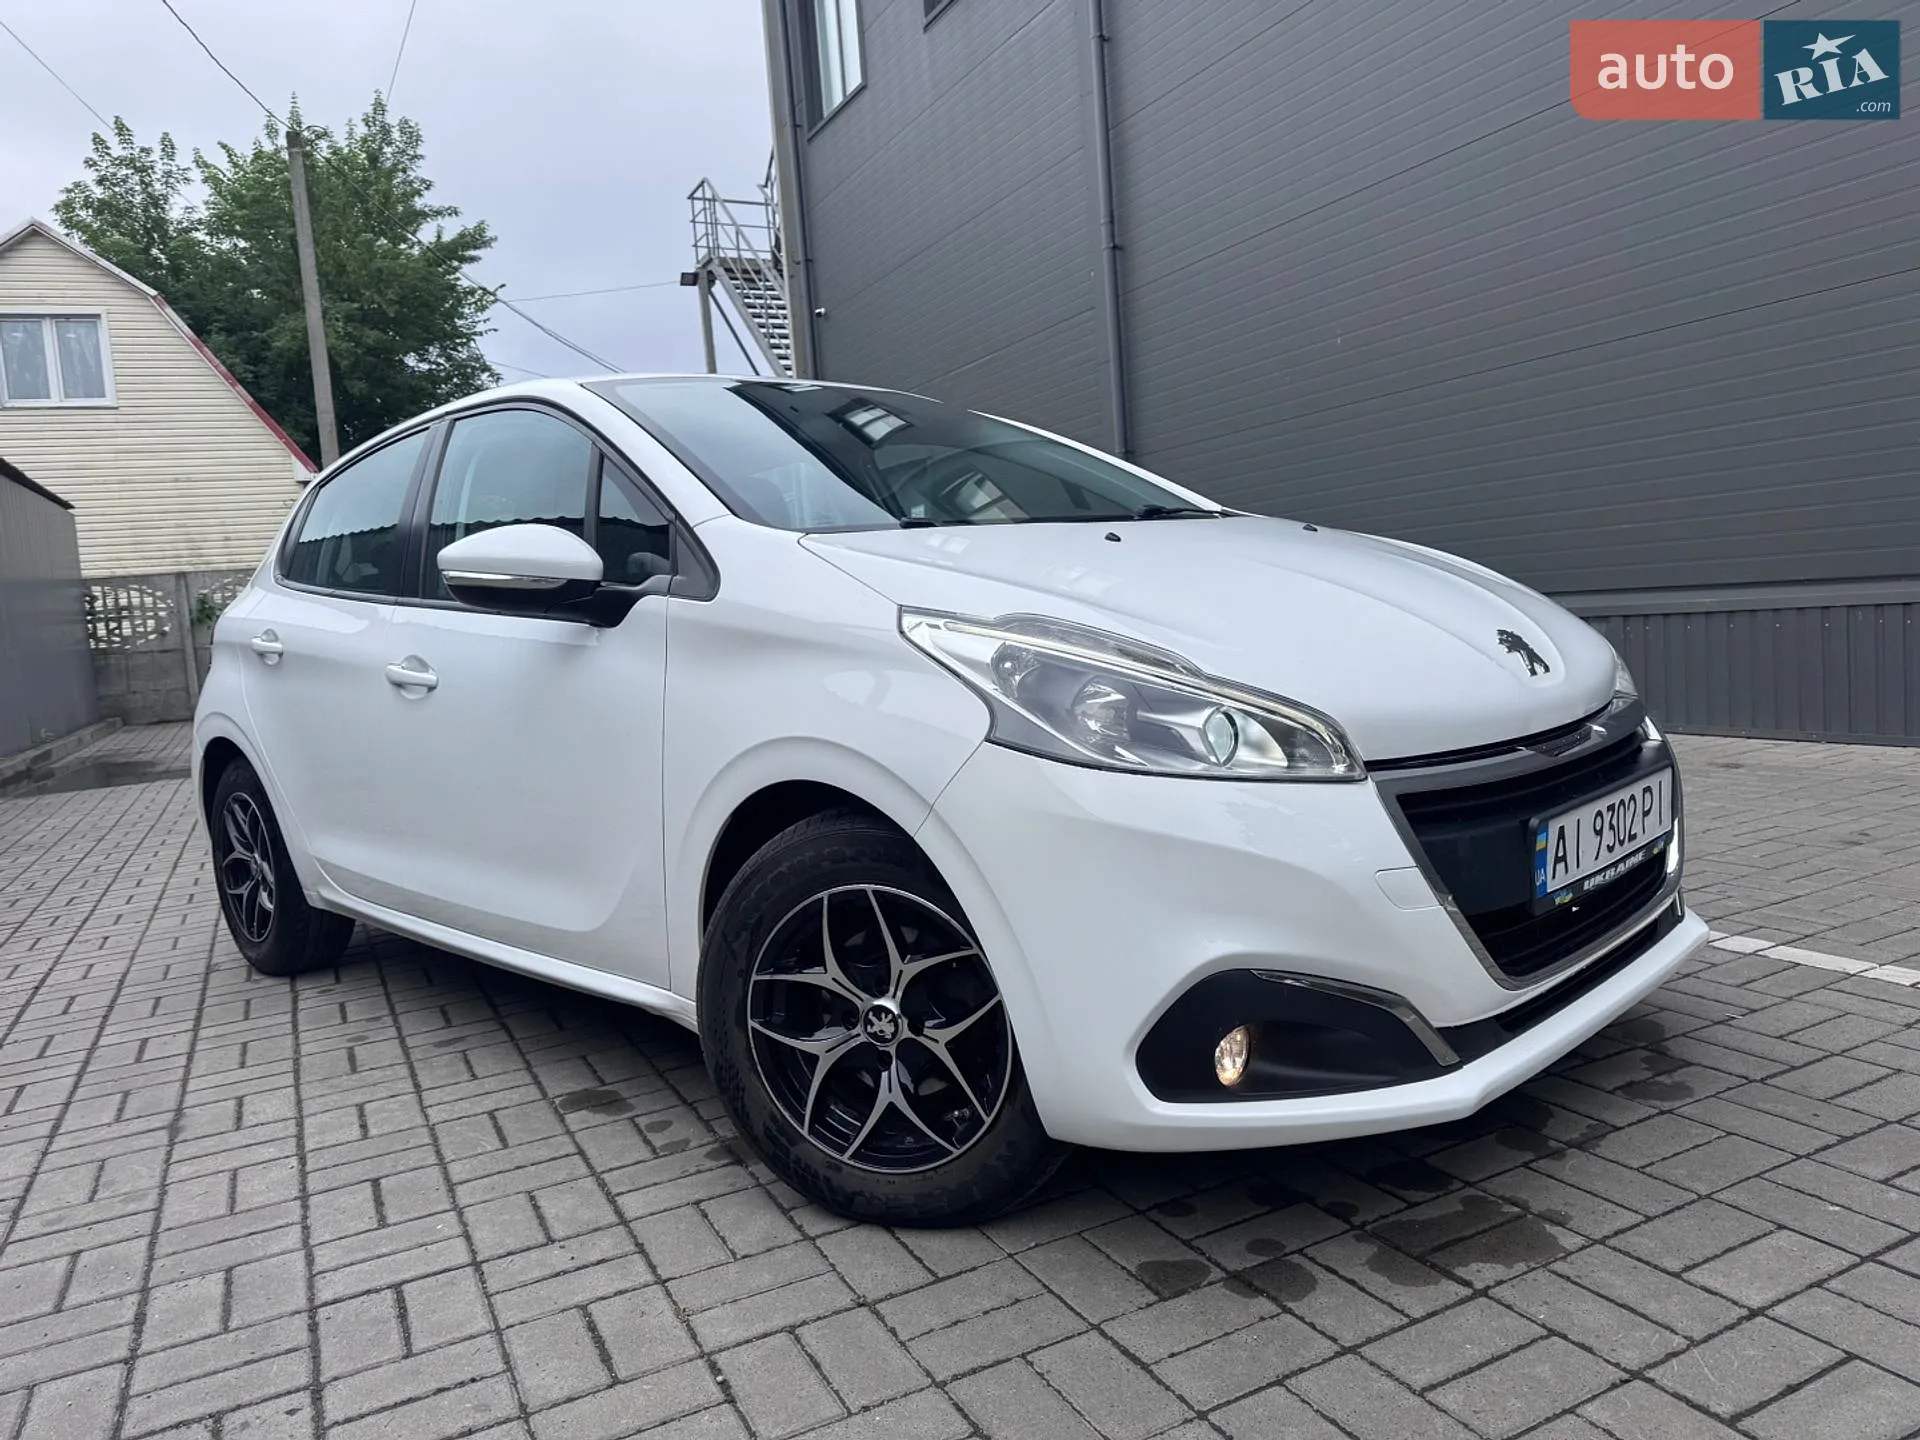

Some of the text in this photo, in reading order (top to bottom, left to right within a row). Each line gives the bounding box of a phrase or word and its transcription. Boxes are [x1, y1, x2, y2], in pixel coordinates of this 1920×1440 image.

[1551, 780, 1663, 880] AI 9302 PI
[1535, 868, 1546, 886] UA
